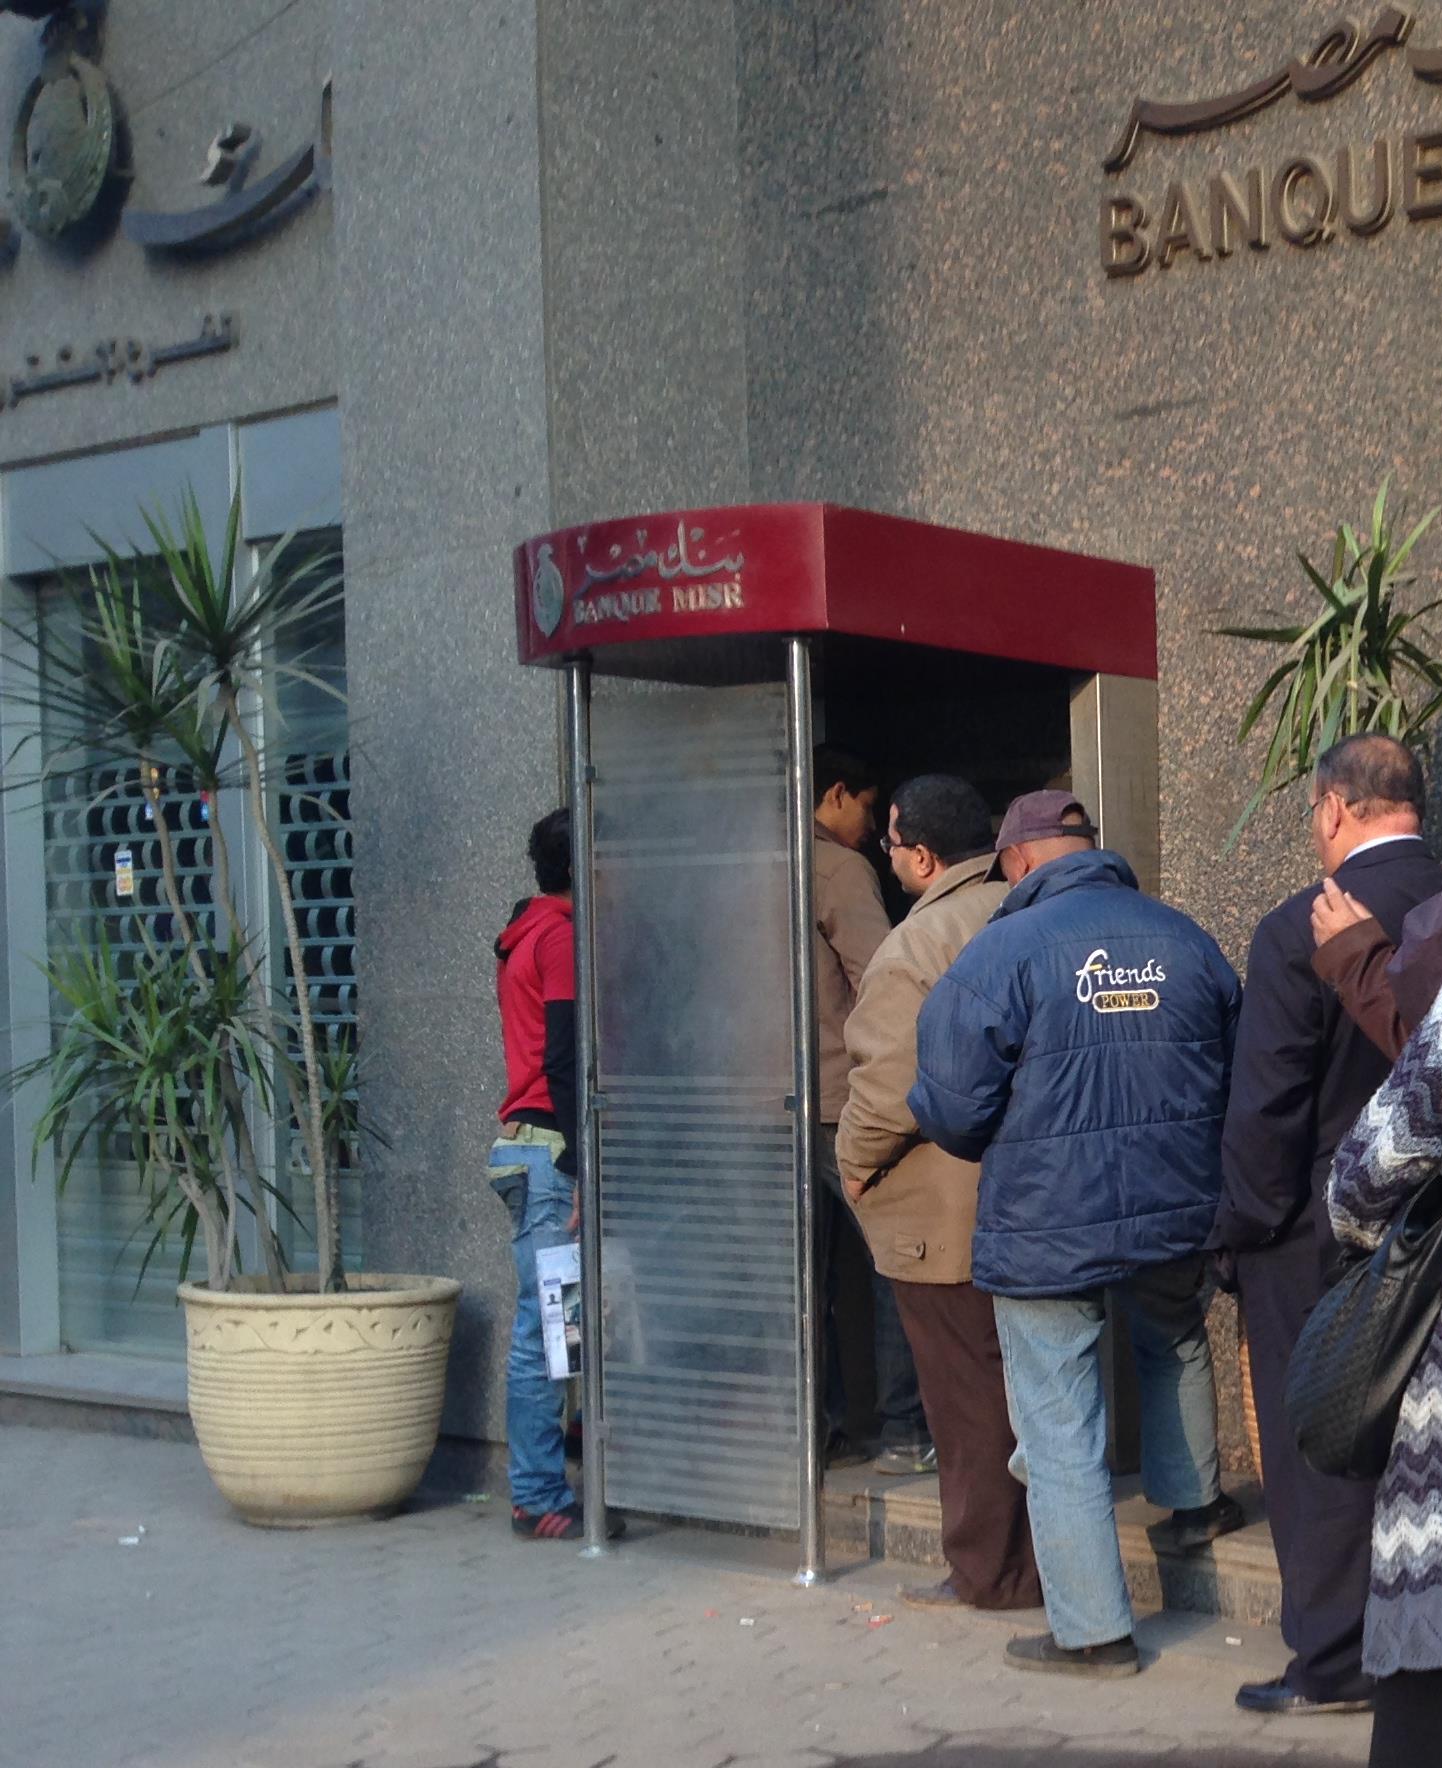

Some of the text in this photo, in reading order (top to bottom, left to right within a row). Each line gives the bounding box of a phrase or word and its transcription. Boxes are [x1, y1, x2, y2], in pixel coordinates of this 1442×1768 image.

[573, 581, 744, 624] BANQUE MISR
[1101, 993, 1150, 1009] POWER
